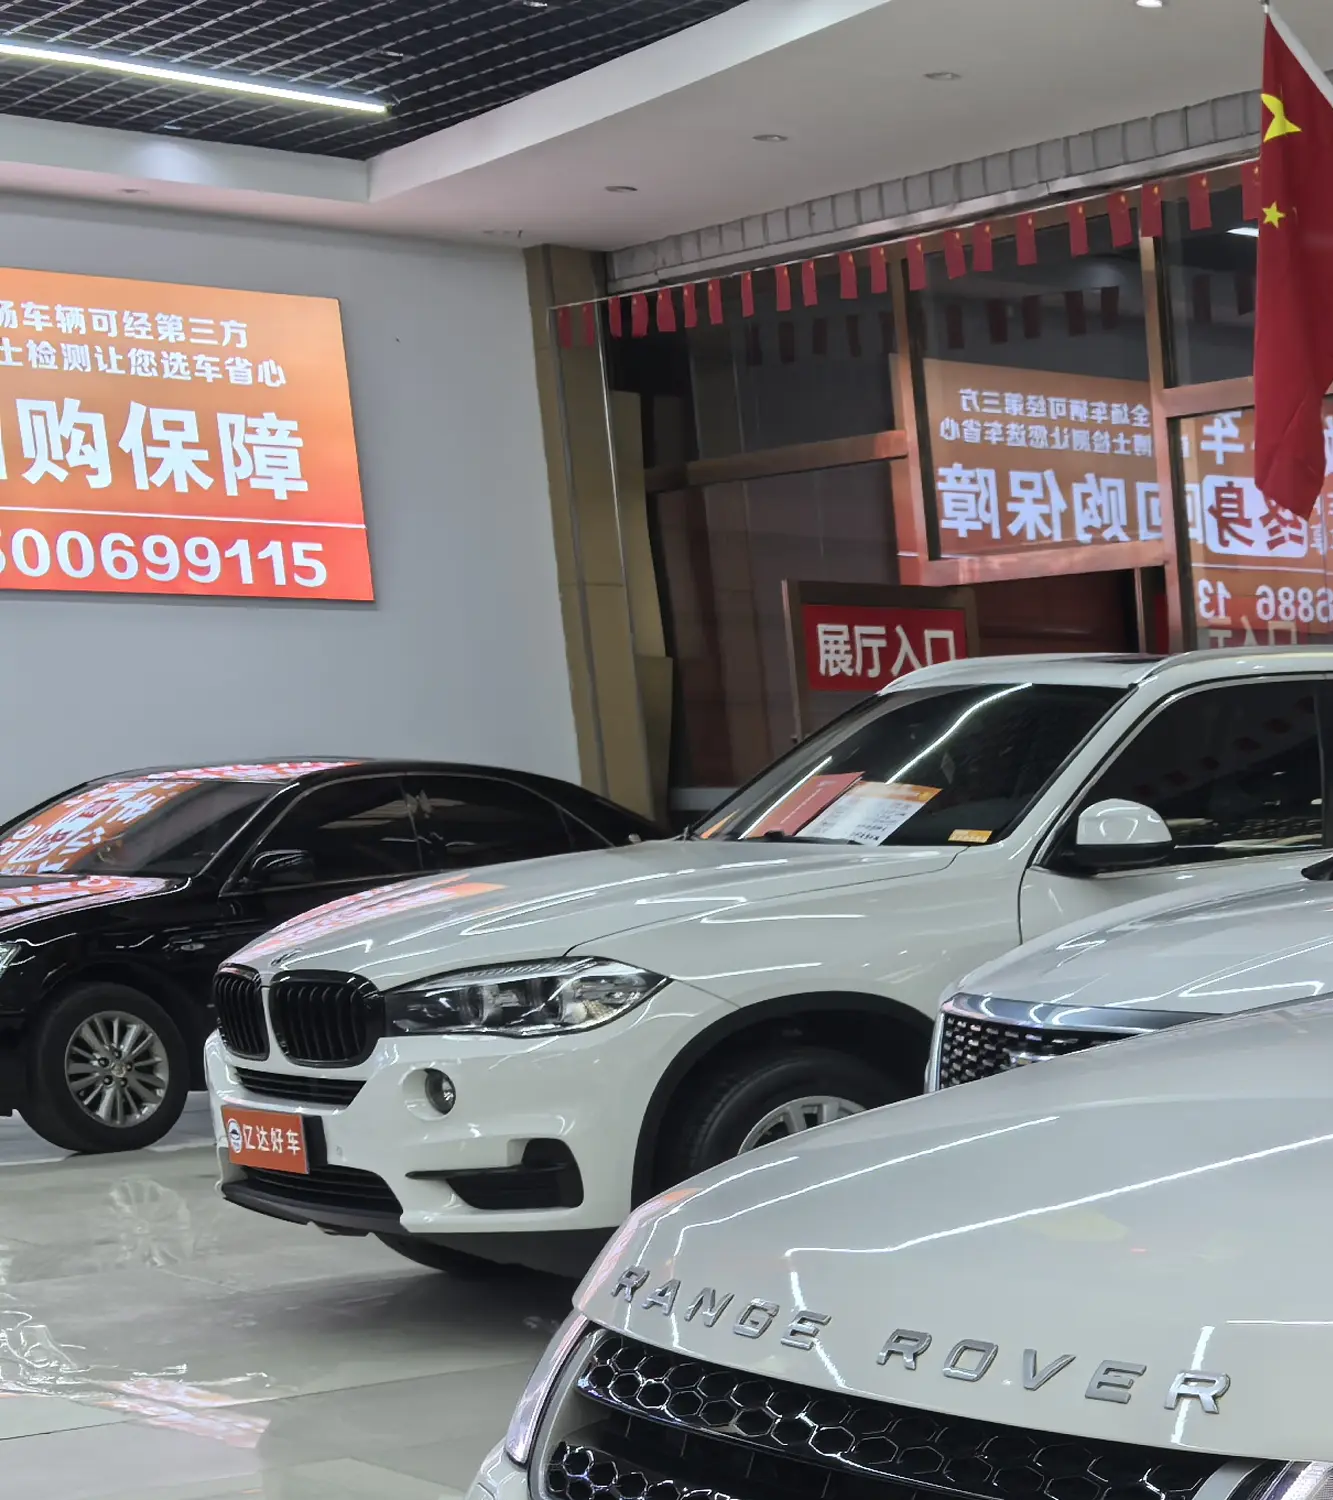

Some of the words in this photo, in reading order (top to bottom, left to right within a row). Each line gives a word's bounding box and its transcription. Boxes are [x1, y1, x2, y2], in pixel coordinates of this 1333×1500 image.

[0, 397, 309, 500] 购保障
[0, 527, 328, 588] 00699115
[817, 623, 956, 678] 展厅入口
[242, 1124, 301, 1156] 亿达好车
[610, 1265, 832, 1352] RANGE
[876, 1328, 1232, 1415] ROVER
